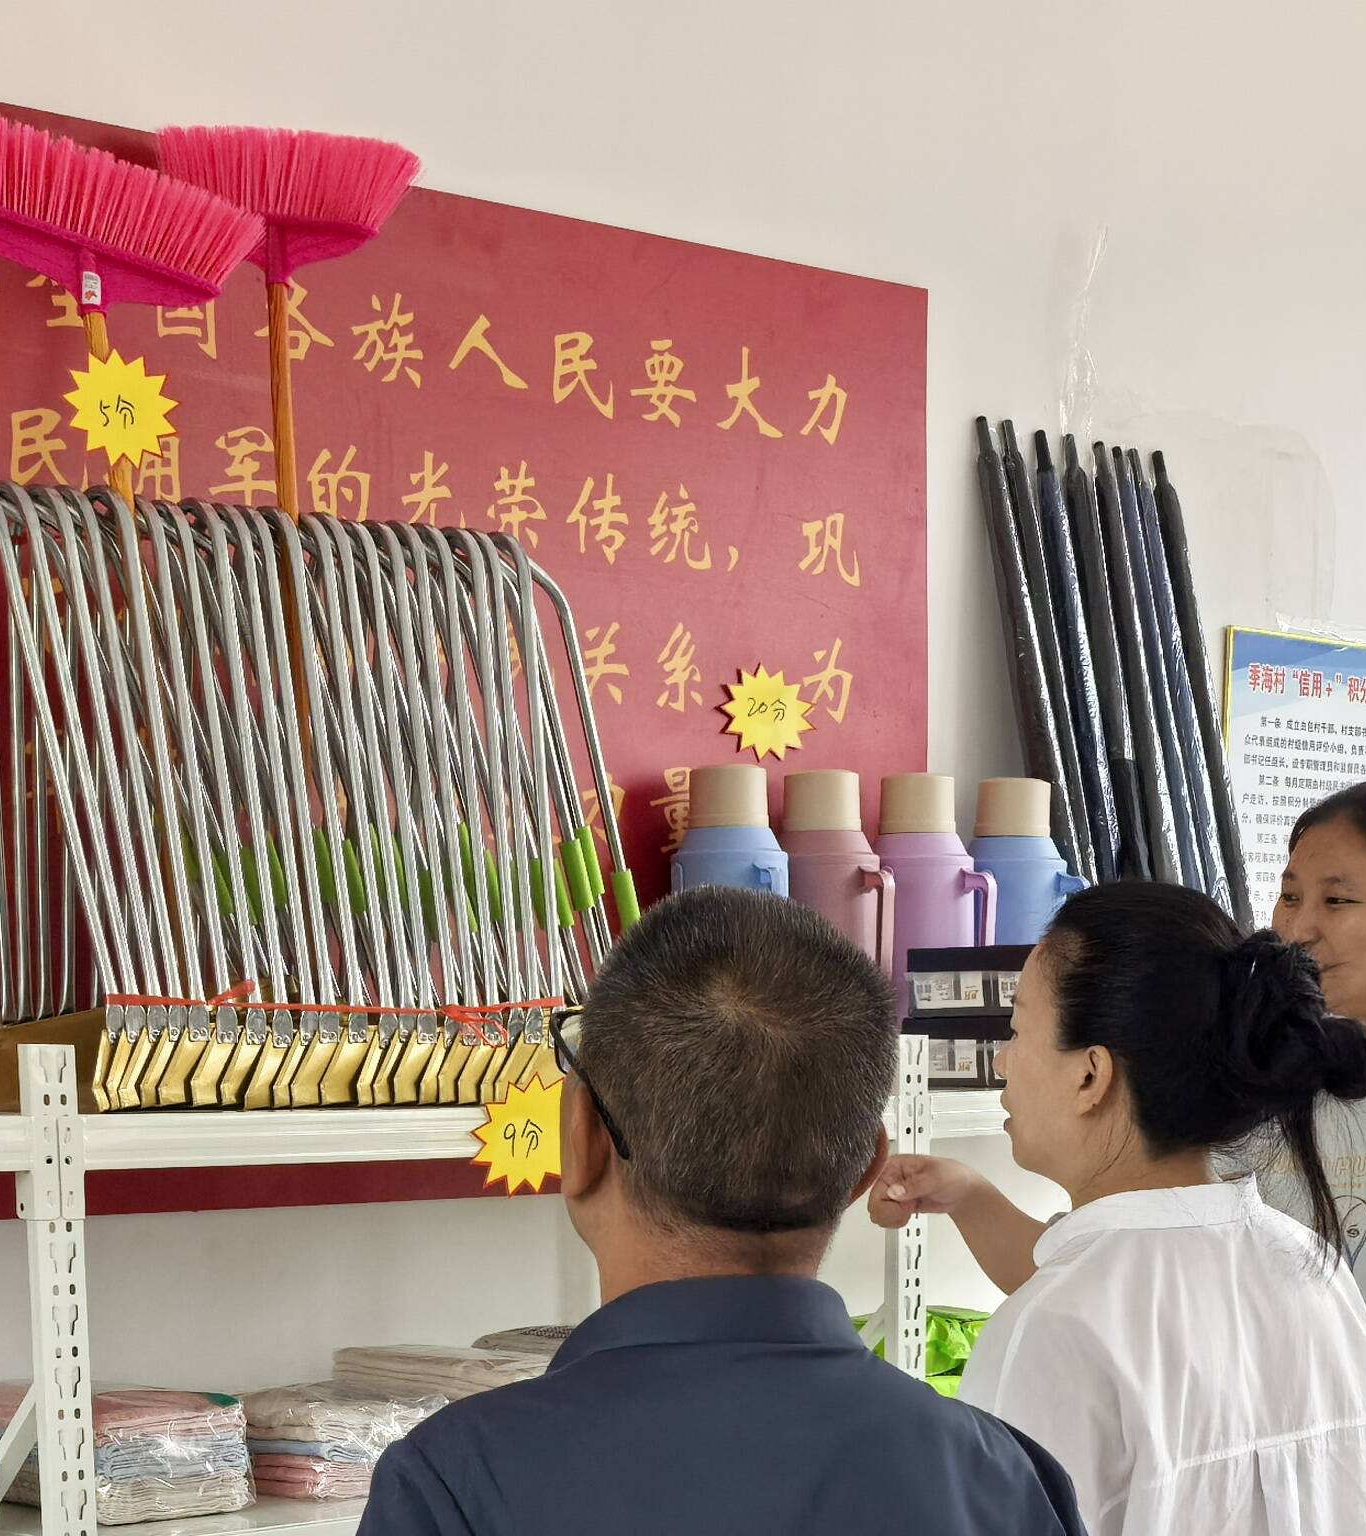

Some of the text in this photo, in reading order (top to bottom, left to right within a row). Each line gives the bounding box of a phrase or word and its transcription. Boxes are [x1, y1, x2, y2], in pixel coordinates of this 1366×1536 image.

[99, 394, 135, 428] 5分
[747, 696, 787, 722] 20分
[503, 1119, 543, 1158] 9分
